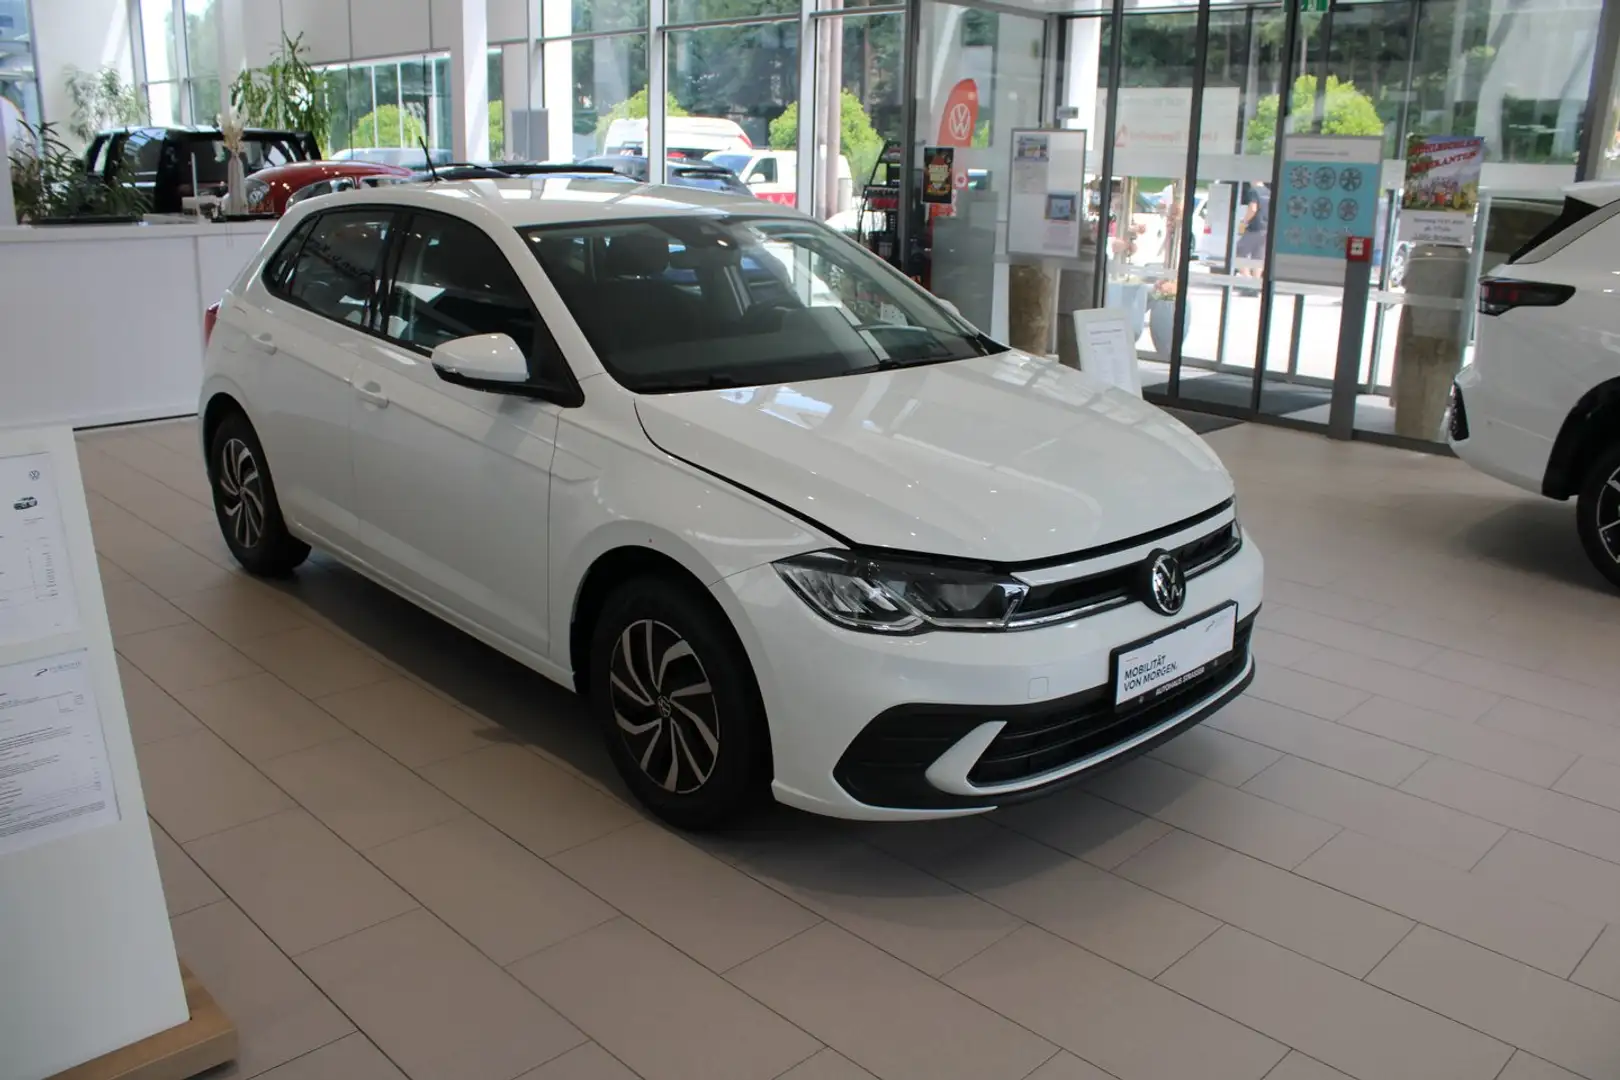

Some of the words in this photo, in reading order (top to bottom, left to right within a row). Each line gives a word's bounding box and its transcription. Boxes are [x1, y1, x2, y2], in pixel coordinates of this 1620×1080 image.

[949, 103, 971, 141] VW
[1152, 554, 1183, 614] VW
[1124, 676, 1142, 692] VON
[1143, 661, 1177, 685] MORGEN.
[1125, 654, 1166, 680] MOBILITÄT
